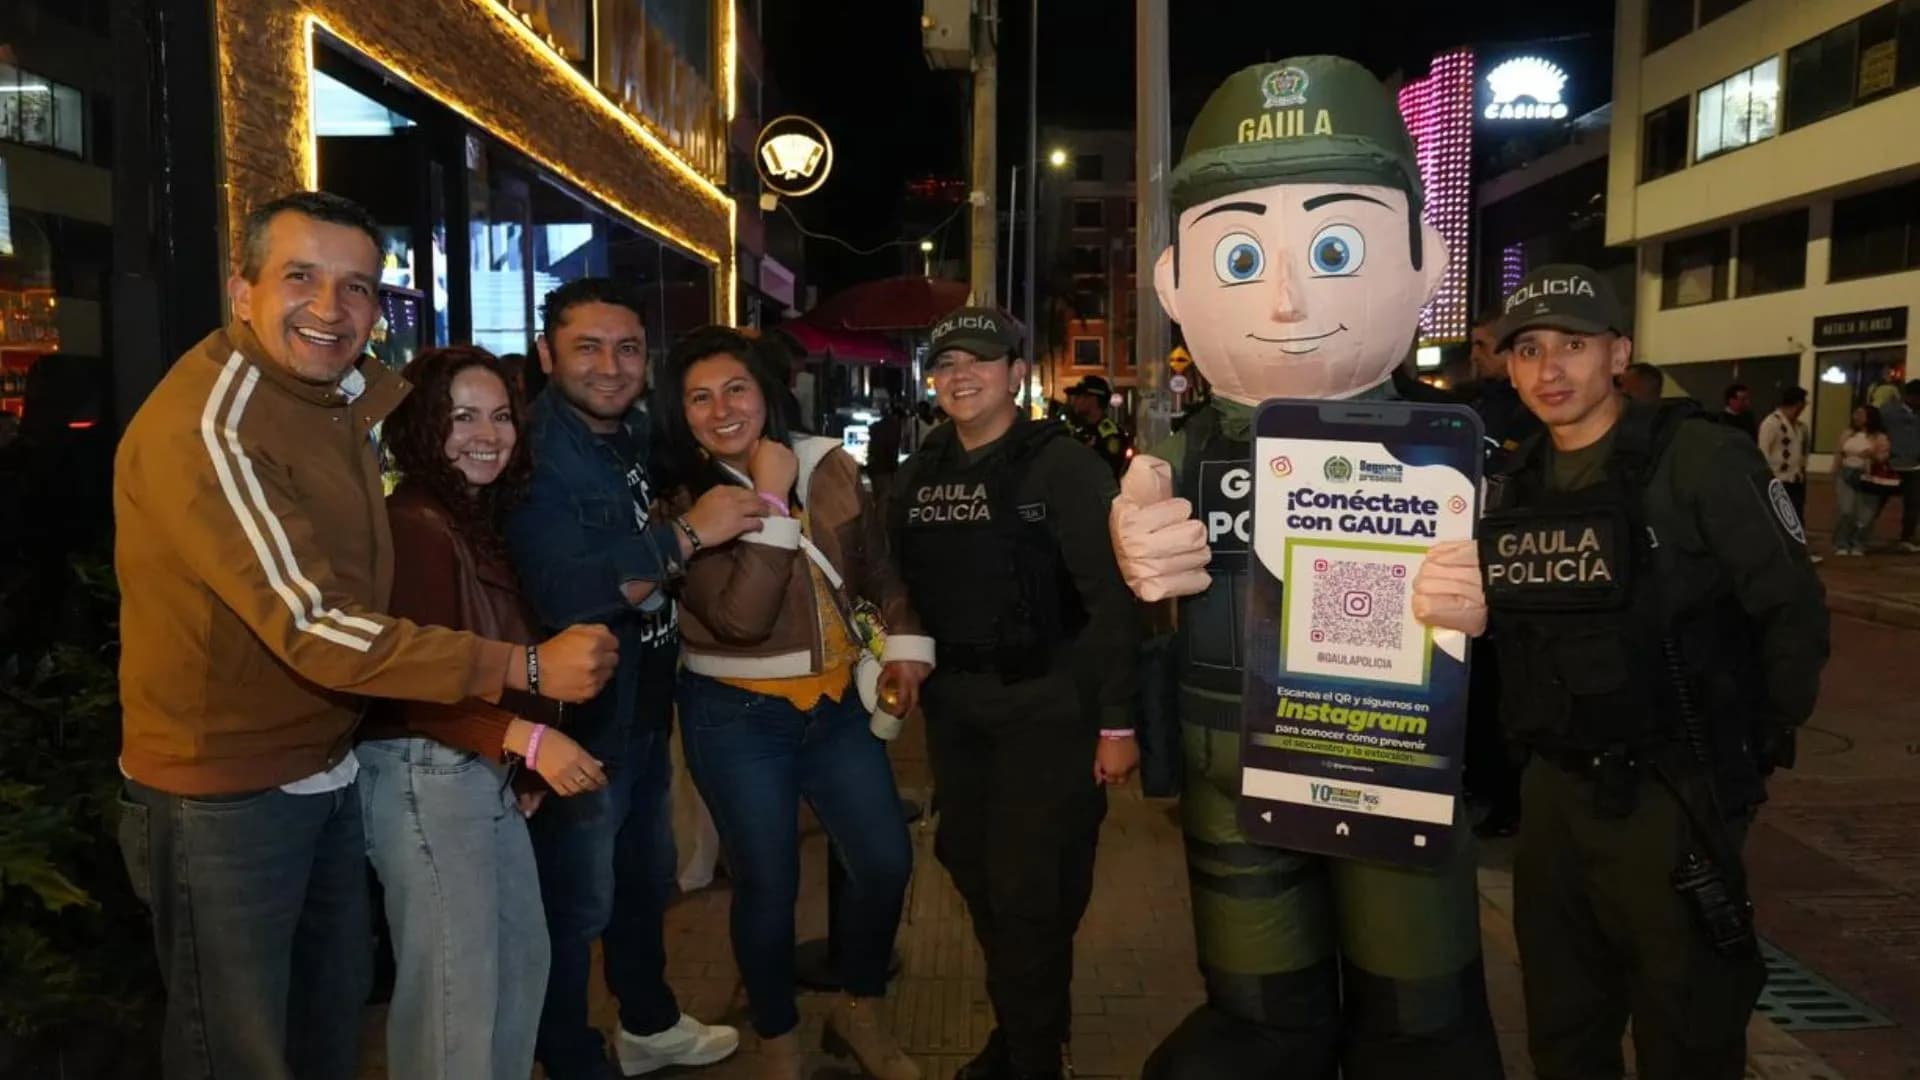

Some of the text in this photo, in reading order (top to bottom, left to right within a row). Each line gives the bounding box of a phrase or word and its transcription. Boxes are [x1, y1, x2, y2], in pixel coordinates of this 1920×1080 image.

[1484, 103, 1568, 119] CASINO
[1238, 110, 1333, 143] GAULA
[1505, 276, 1595, 314] POLICÍA
[931, 315, 997, 343] POLICÍA
[917, 483, 988, 503] GAULA
[1287, 488, 1439, 515] ¡Conéctate
[907, 500, 992, 524] POLICÍA
[1287, 514, 1437, 538] con GAULA!
[1498, 528, 1600, 557] GAULA
[1488, 552, 1612, 586] POLICÍA
[1276, 686, 1321, 701] Escanea
[1322, 691, 1333, 701] el
[1334, 692, 1352, 704] QR
[1352, 696, 1361, 706] y
[1414, 702, 1430, 713] en
[1277, 698, 1427, 734] Instagram
[1275, 724, 1299, 736] para
[1301, 727, 1345, 741] conocer
[1379, 735, 1428, 751] prevenir
